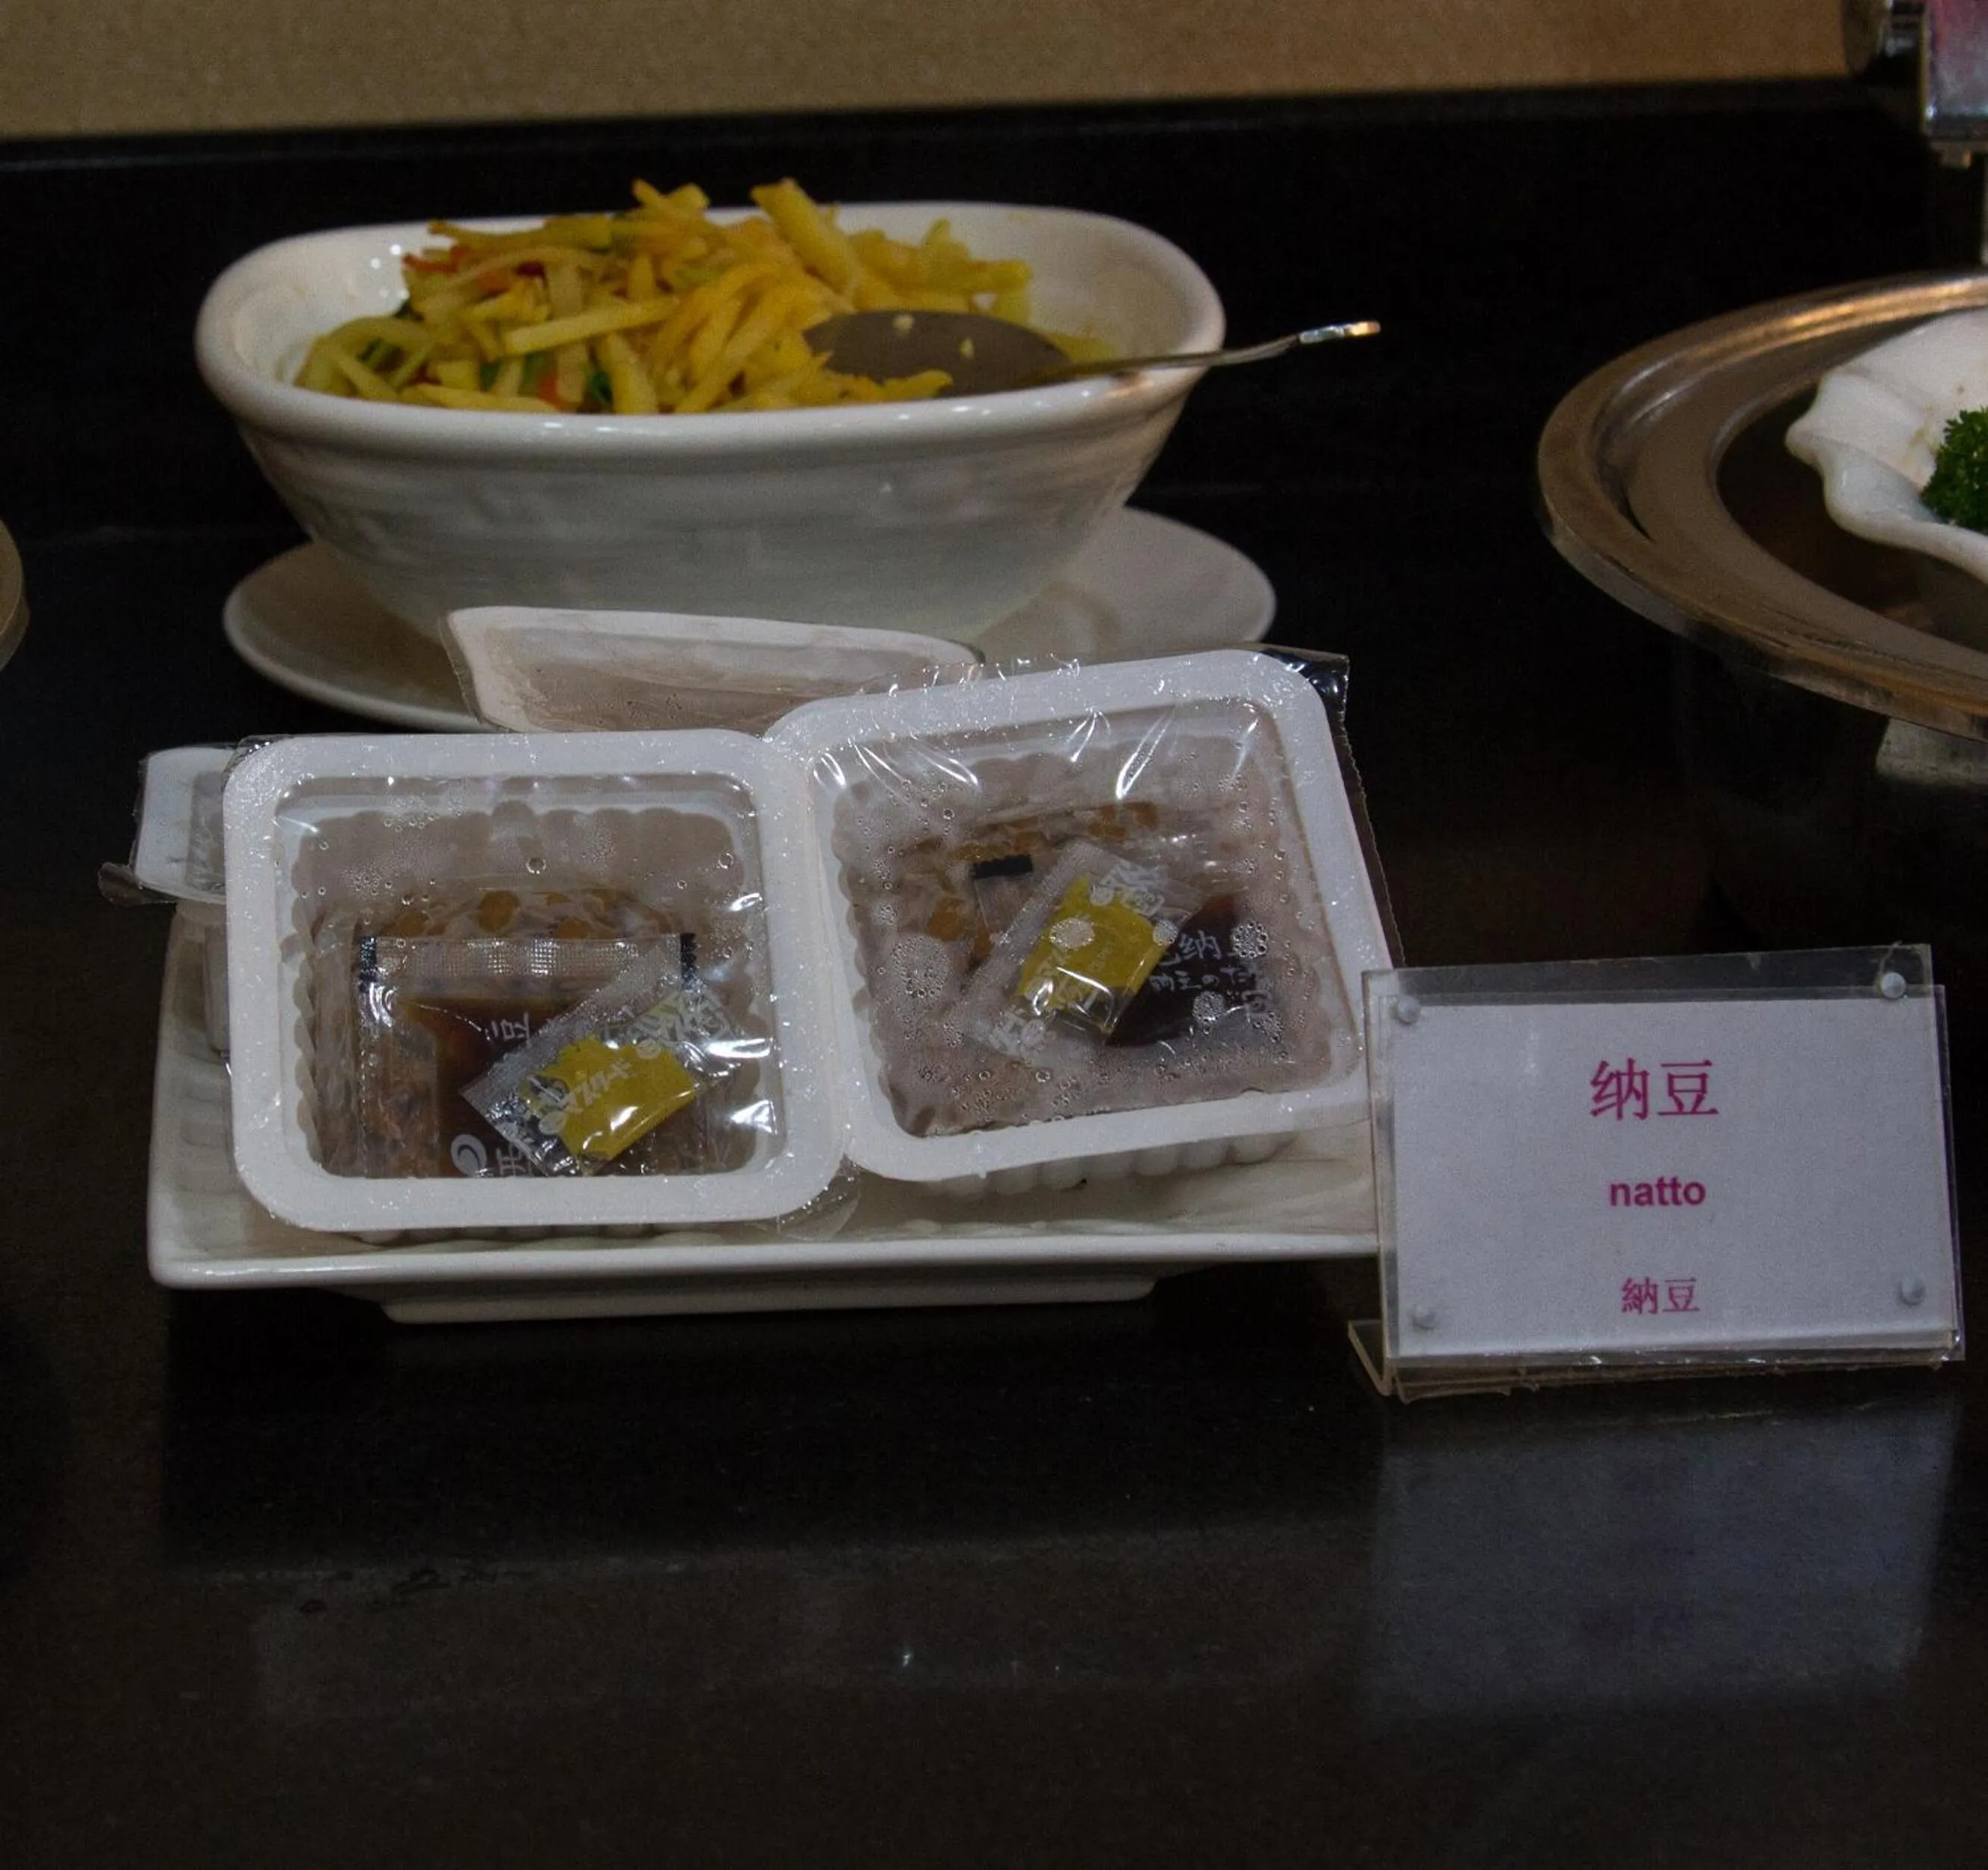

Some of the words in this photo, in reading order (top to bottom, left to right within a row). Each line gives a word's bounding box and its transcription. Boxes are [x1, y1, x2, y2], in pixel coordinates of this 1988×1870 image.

[1590, 1057, 1719, 1121] 纳豆
[1608, 1177, 1707, 1207] natto
[1622, 1277, 1700, 1315] 納豆
